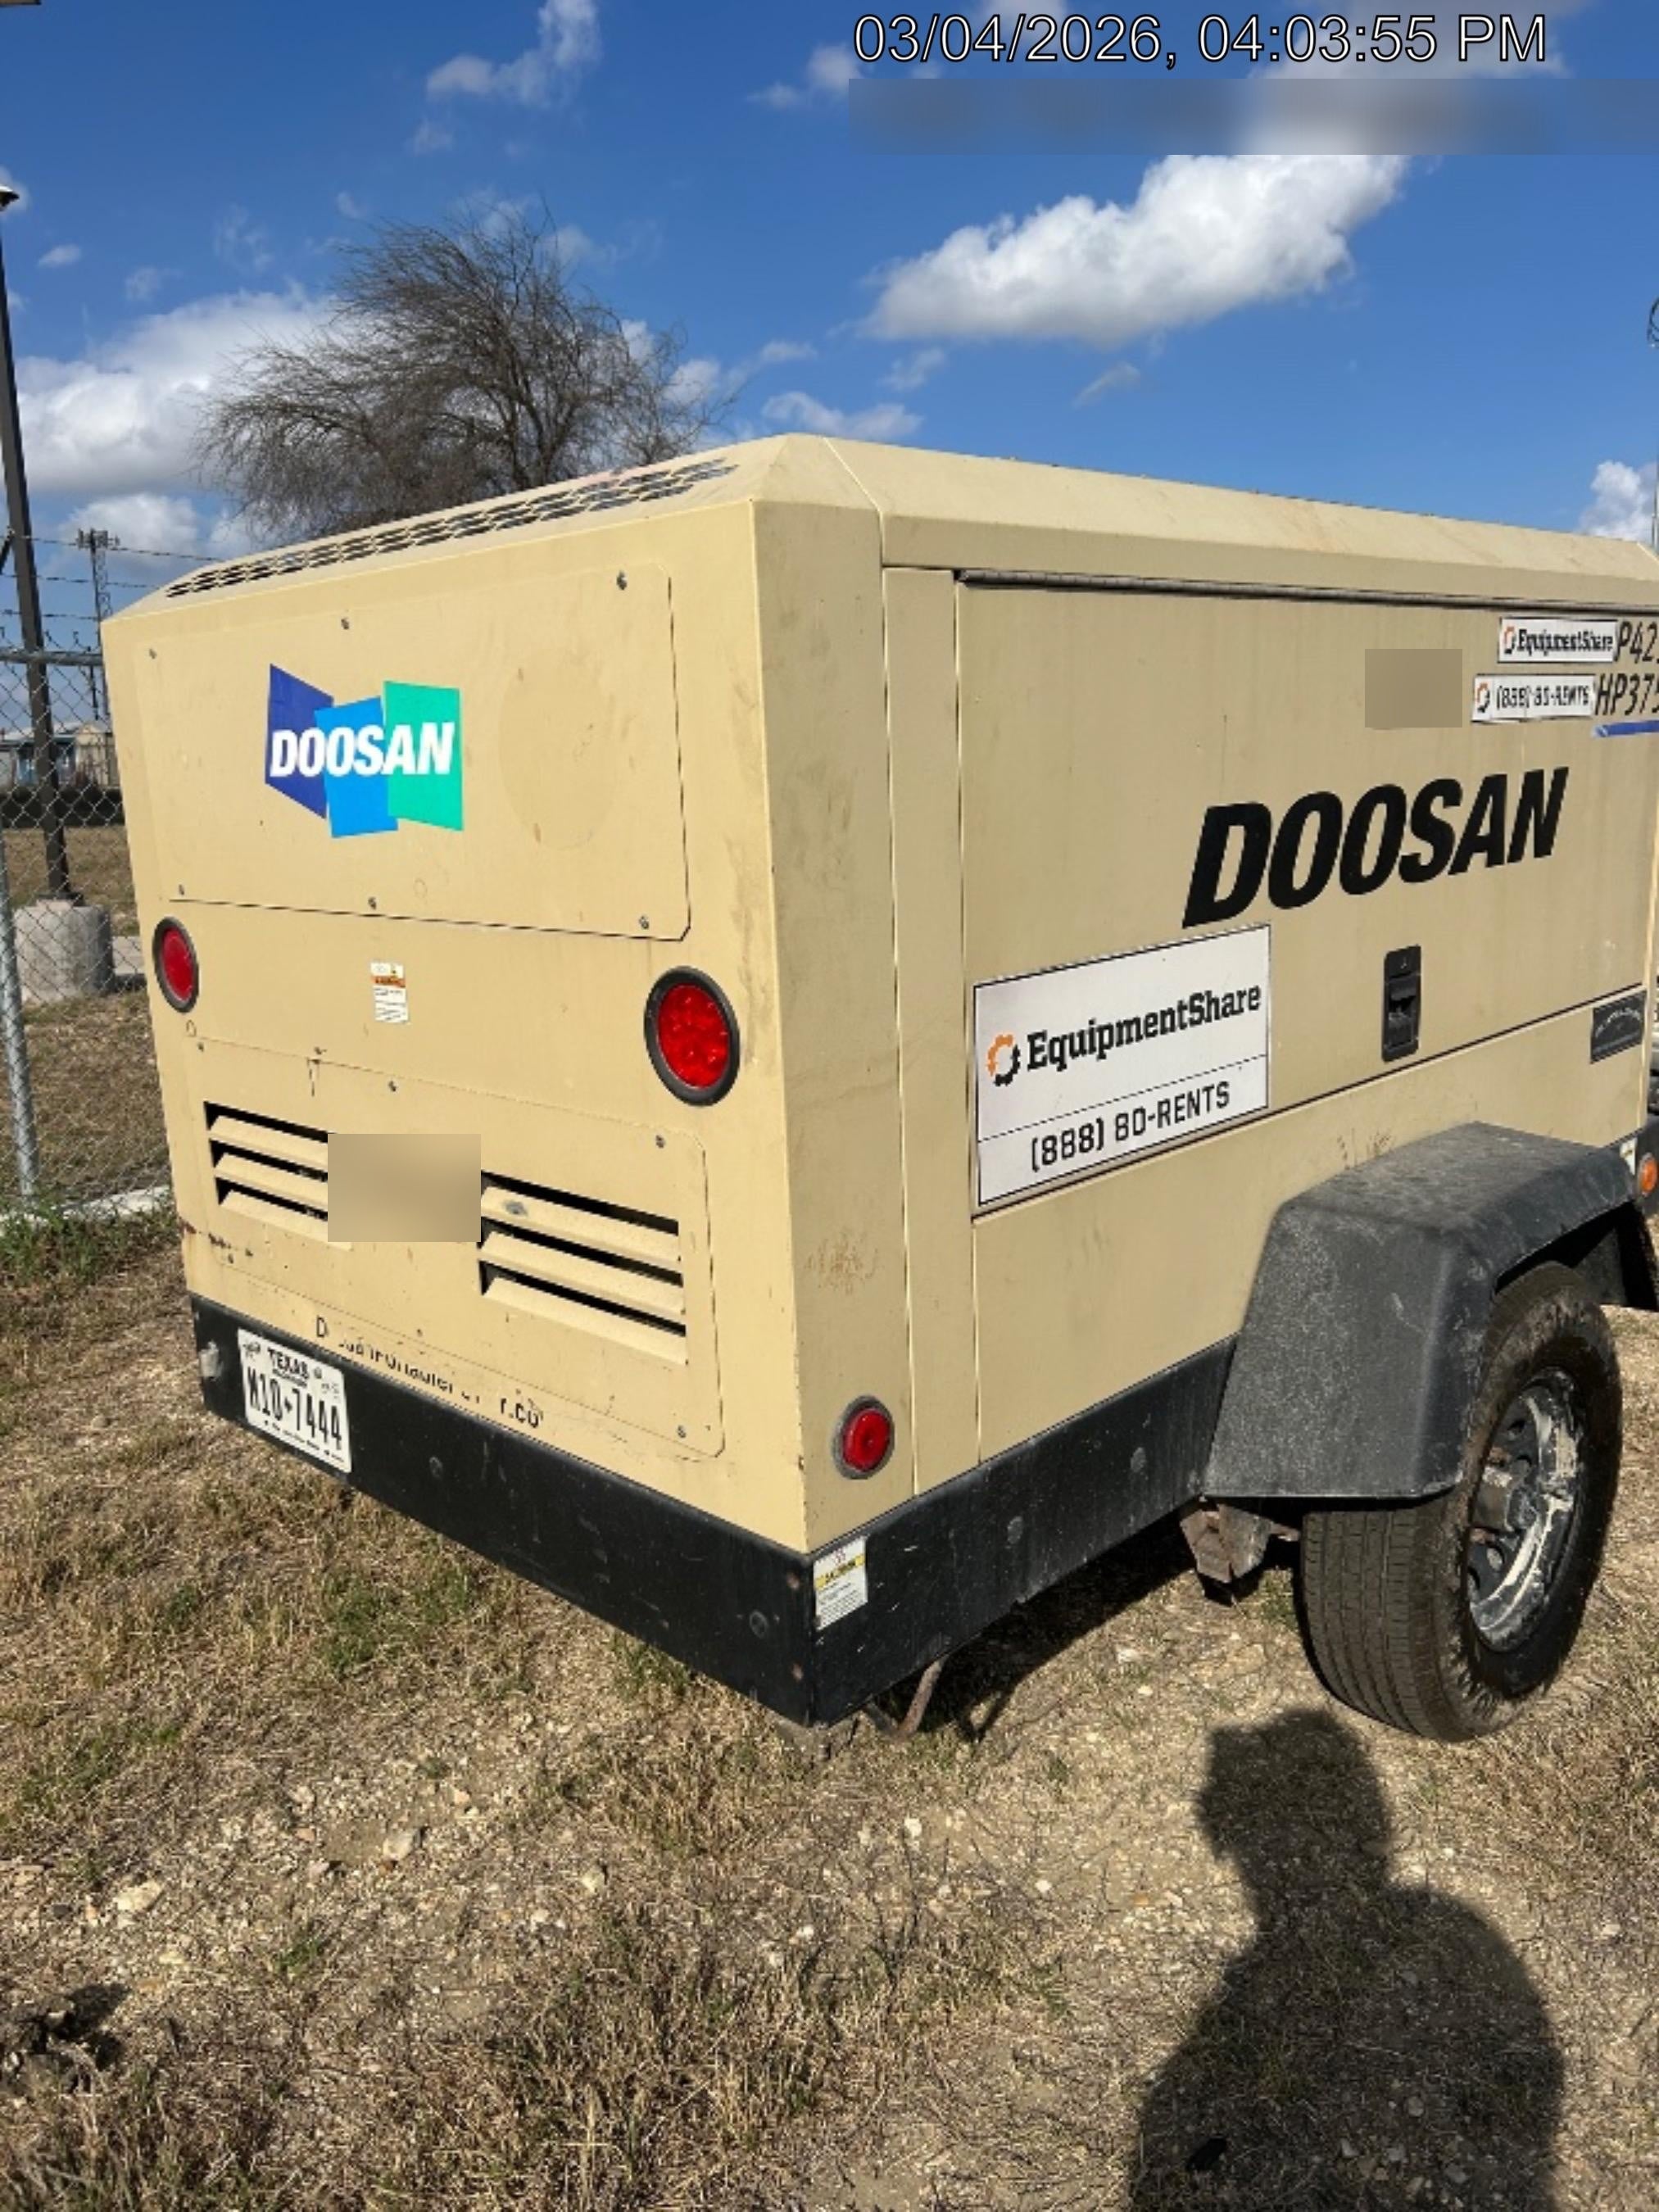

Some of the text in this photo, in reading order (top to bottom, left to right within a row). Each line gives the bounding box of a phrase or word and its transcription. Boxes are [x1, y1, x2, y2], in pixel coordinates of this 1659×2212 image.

[1613, 620, 1659, 664] P42
[270, 721, 456, 777] DOOSAN
[1182, 766, 1569, 929] DOOSAN
[1026, 985, 1262, 1072] EquipmentShare
[1114, 1080, 1231, 1142] 80-RENTS
[267, 1347, 310, 1380] TEXAS
